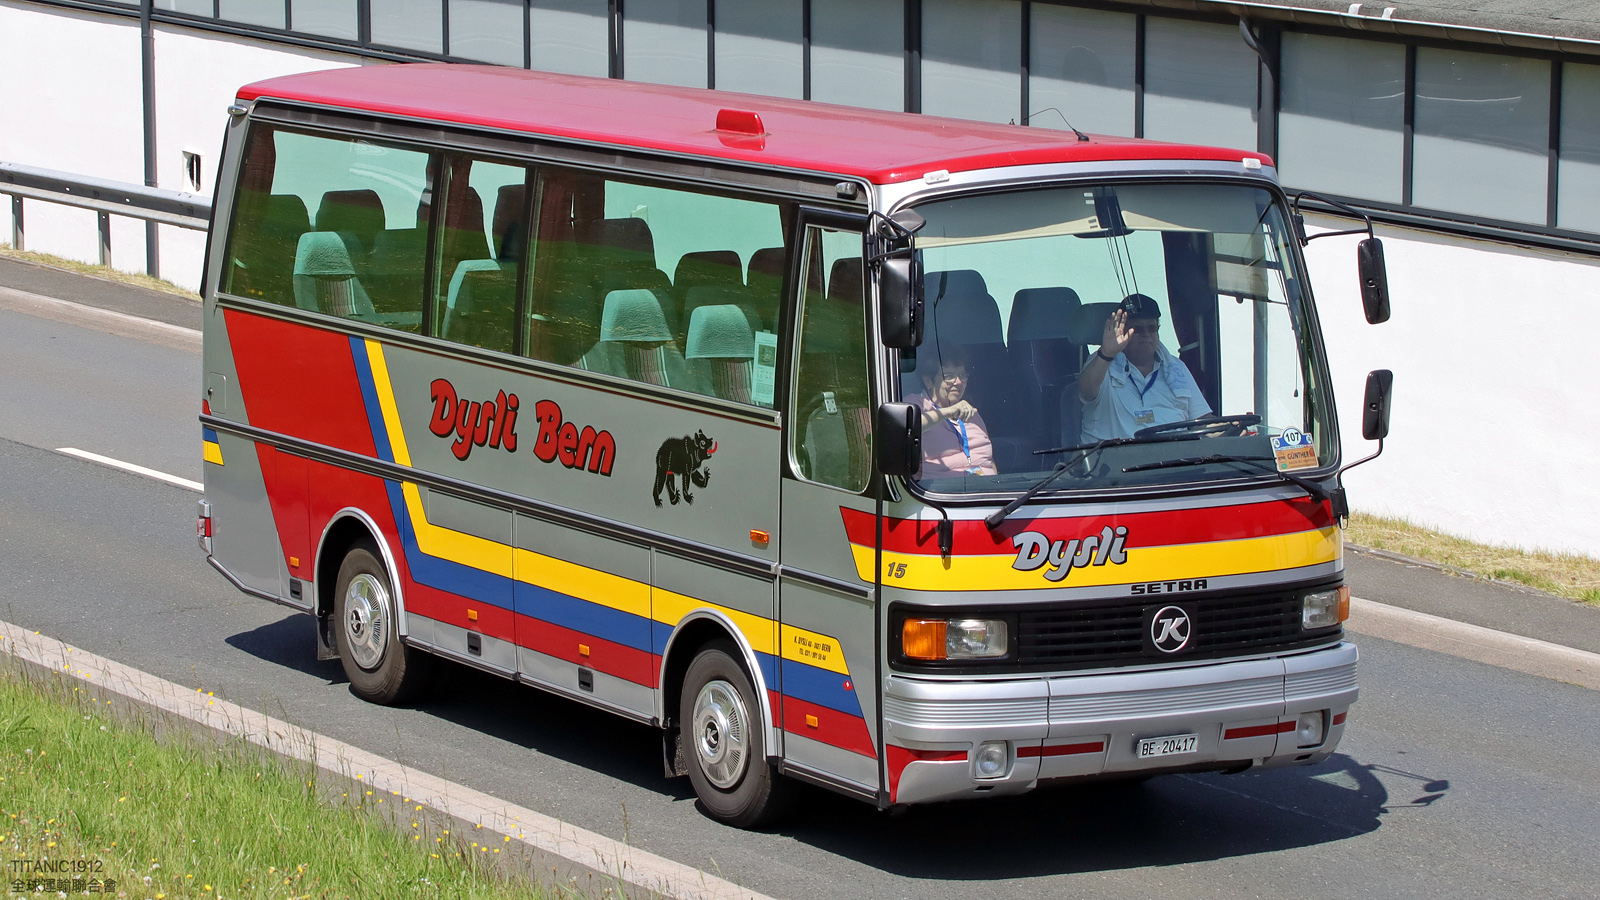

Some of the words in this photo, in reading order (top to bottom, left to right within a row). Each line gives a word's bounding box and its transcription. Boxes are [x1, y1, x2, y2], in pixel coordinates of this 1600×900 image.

[428, 378, 520, 462] Dysli
[533, 399, 617, 477] Bern
[1285, 432, 1299, 442] 107
[1011, 525, 1129, 582] Dysli
[887, 562, 908, 578] 15
[1131, 579, 1208, 595] SETRA
[1155, 617, 1187, 643] K
[822, 643, 831, 652] BERN
[1142, 741, 1156, 756] BE
[1162, 737, 1196, 753] 20417
